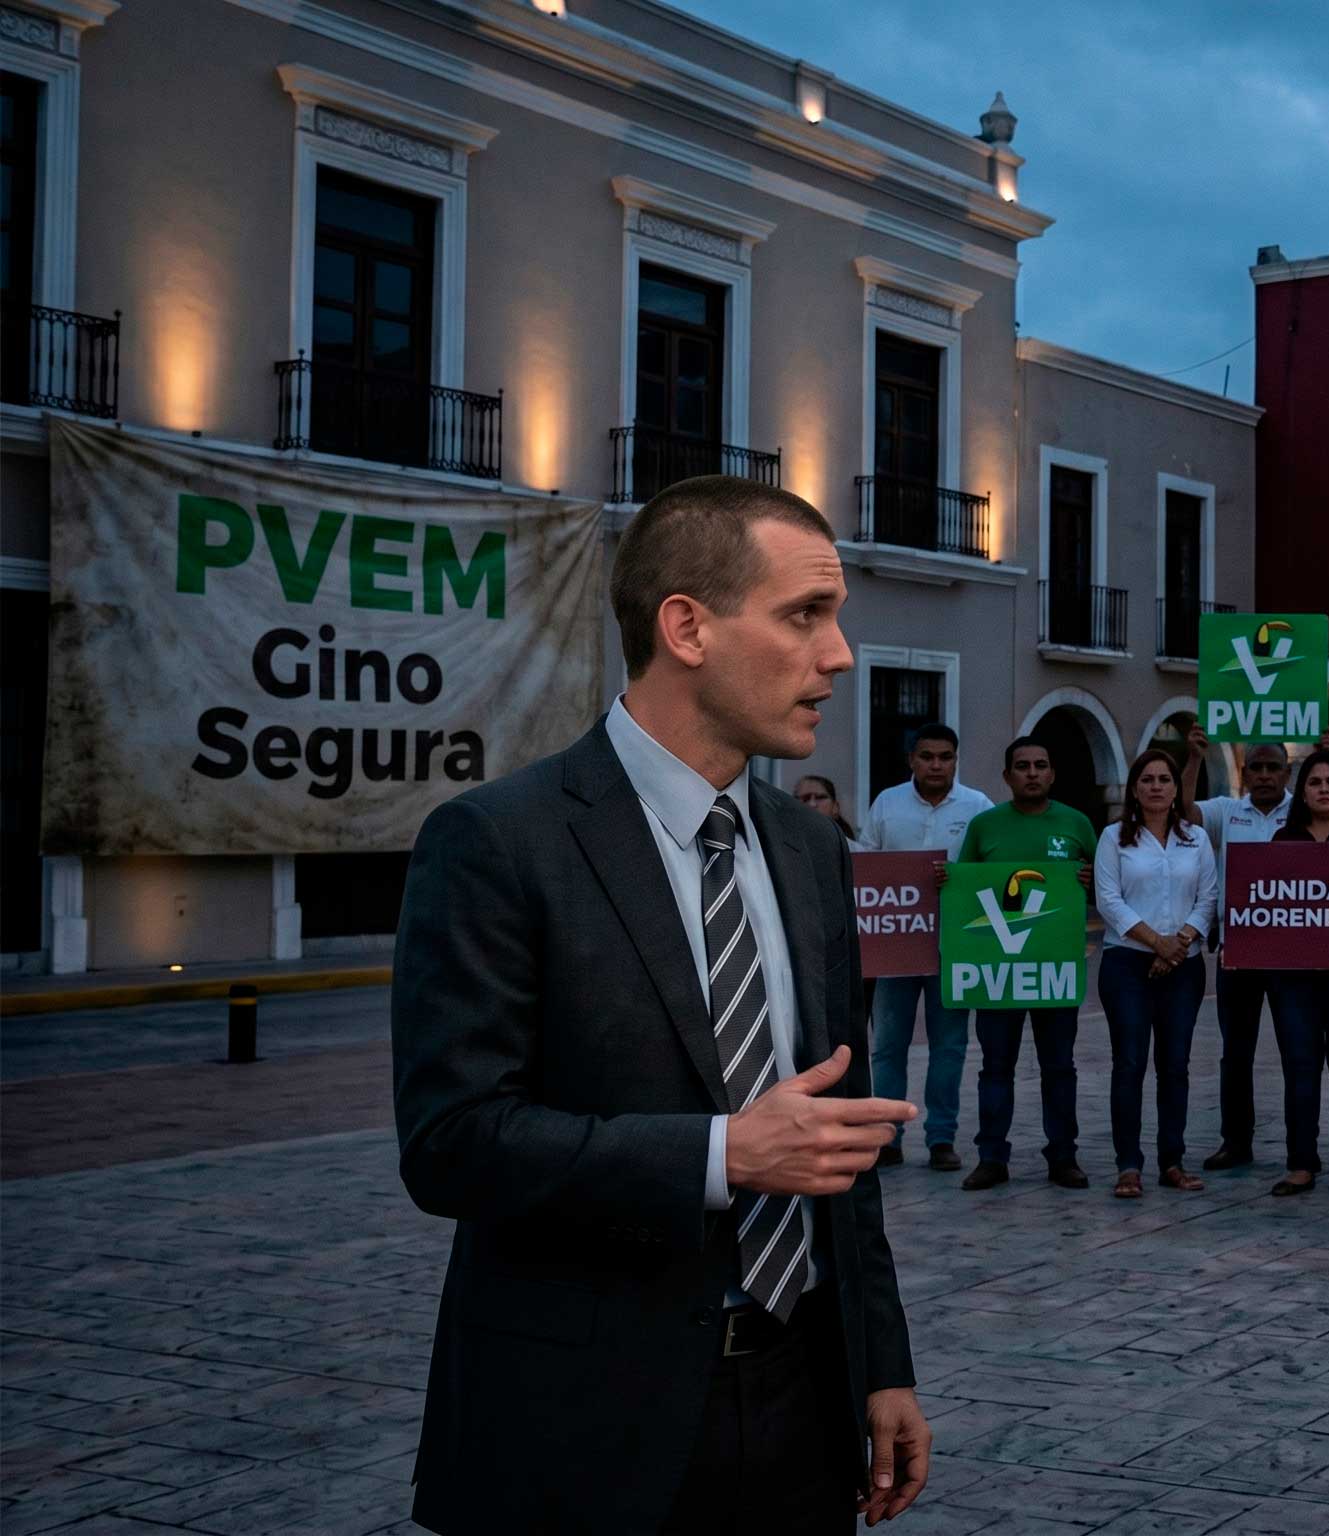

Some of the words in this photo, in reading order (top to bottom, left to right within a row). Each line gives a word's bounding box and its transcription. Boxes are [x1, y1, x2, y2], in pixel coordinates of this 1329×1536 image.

[176, 493, 507, 621] PVEM
[252, 624, 443, 704] Gino
[191, 707, 486, 800] Segura
[1207, 701, 1320, 736] PVEM
[952, 962, 1077, 1001] PVEM
